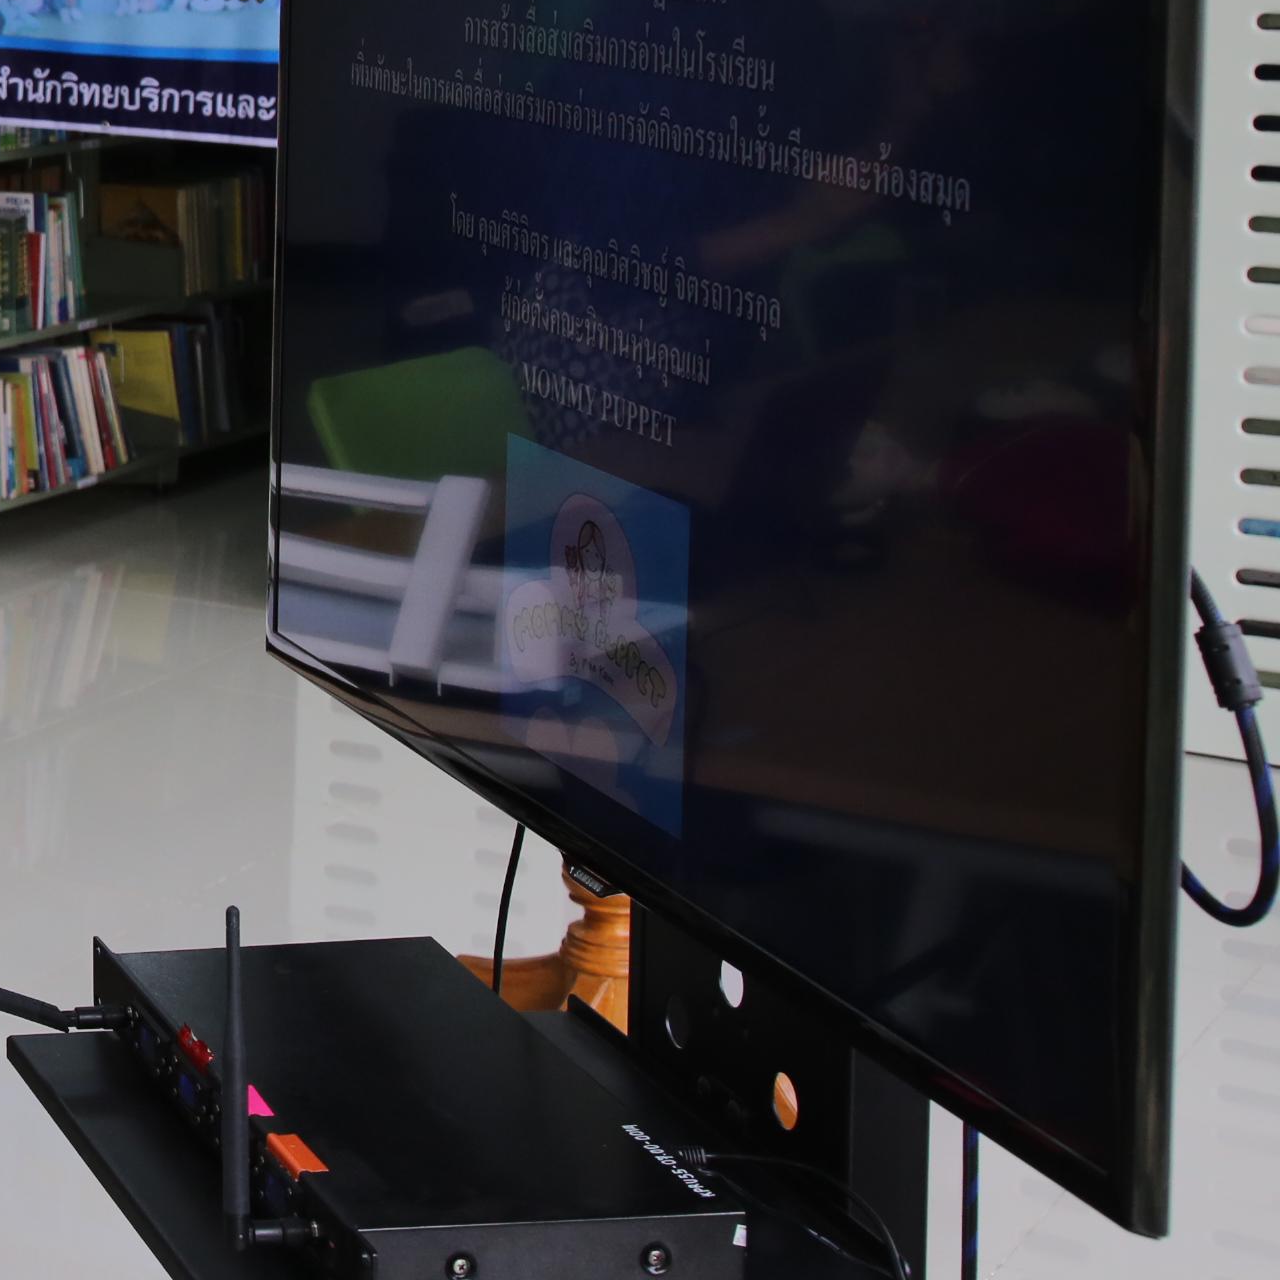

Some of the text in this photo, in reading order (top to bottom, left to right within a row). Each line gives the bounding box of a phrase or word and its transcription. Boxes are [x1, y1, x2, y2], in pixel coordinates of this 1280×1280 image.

[449, 192, 475, 239] โดย
[521, 361, 678, 448] MOMMY PUPPET
